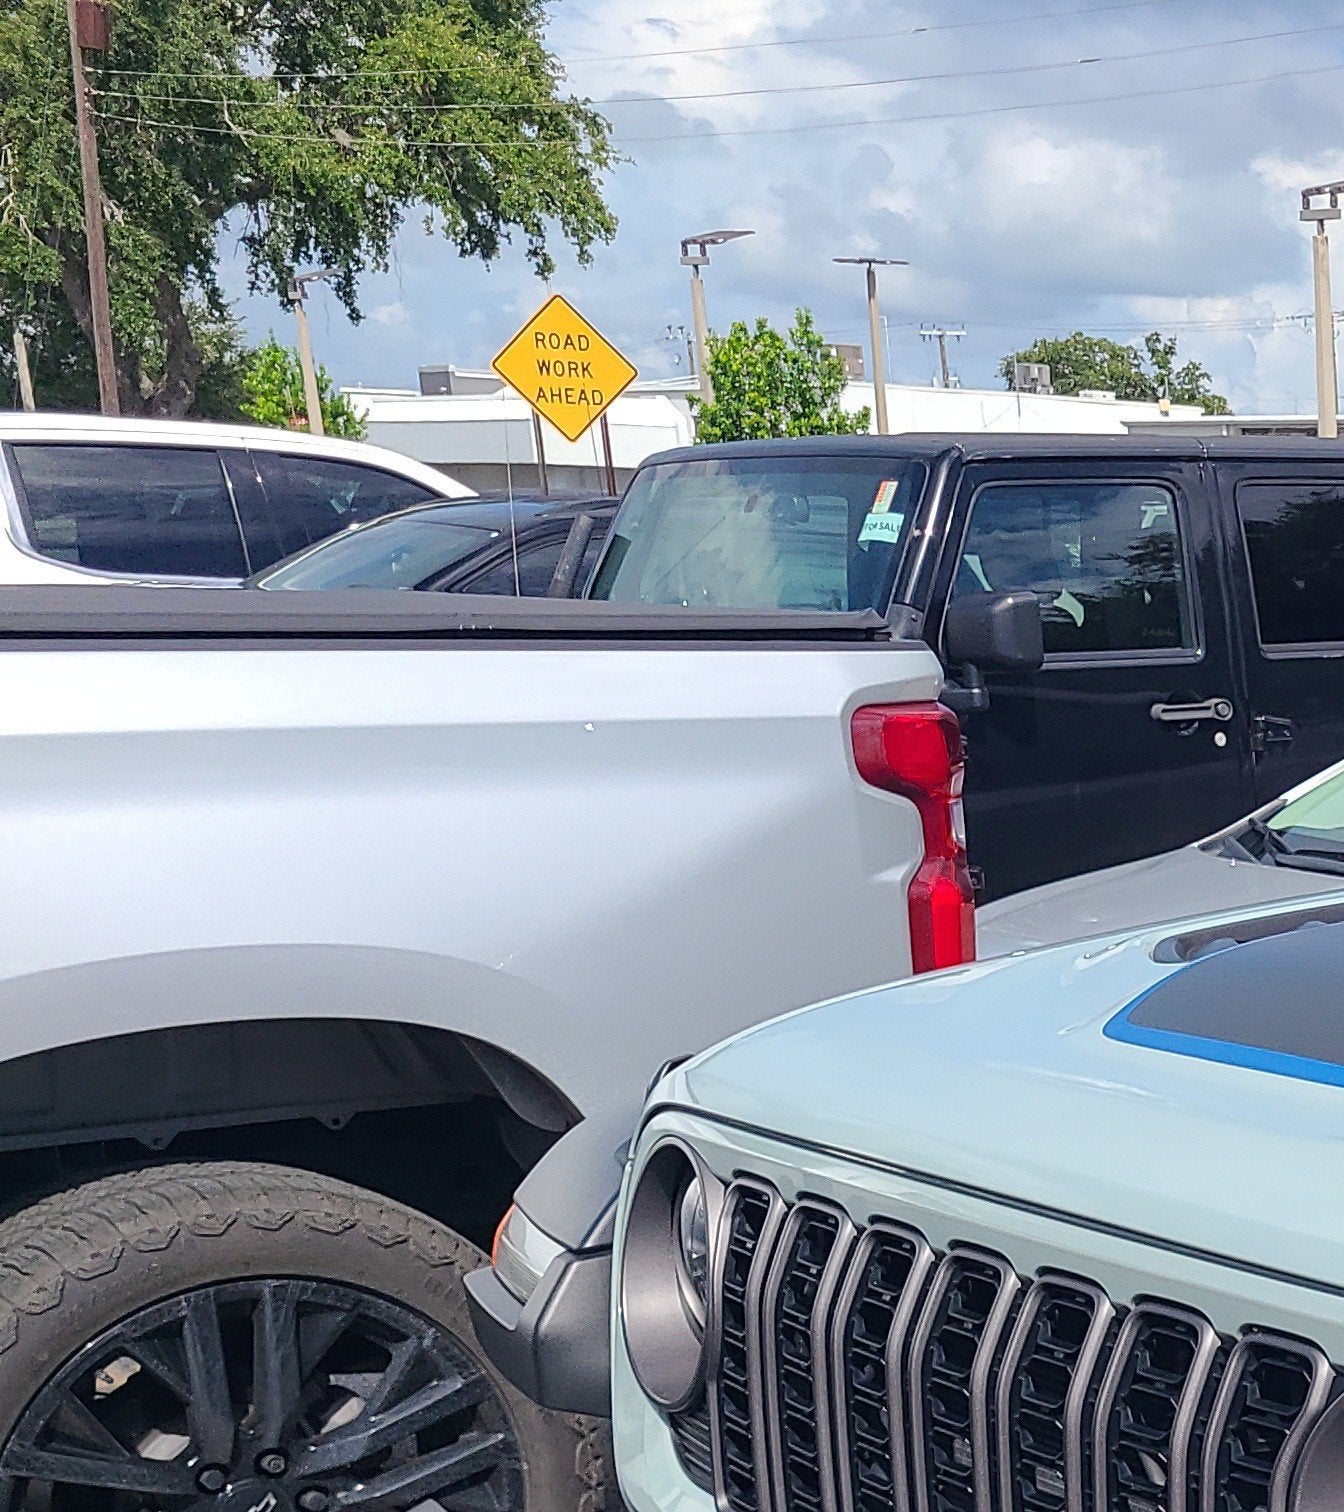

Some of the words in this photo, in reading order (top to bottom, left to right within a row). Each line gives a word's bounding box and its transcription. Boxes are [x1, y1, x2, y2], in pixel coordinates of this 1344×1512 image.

[534, 331, 590, 352] ROAD
[536, 358, 594, 379] WORK
[535, 386, 604, 406] AHEAD
